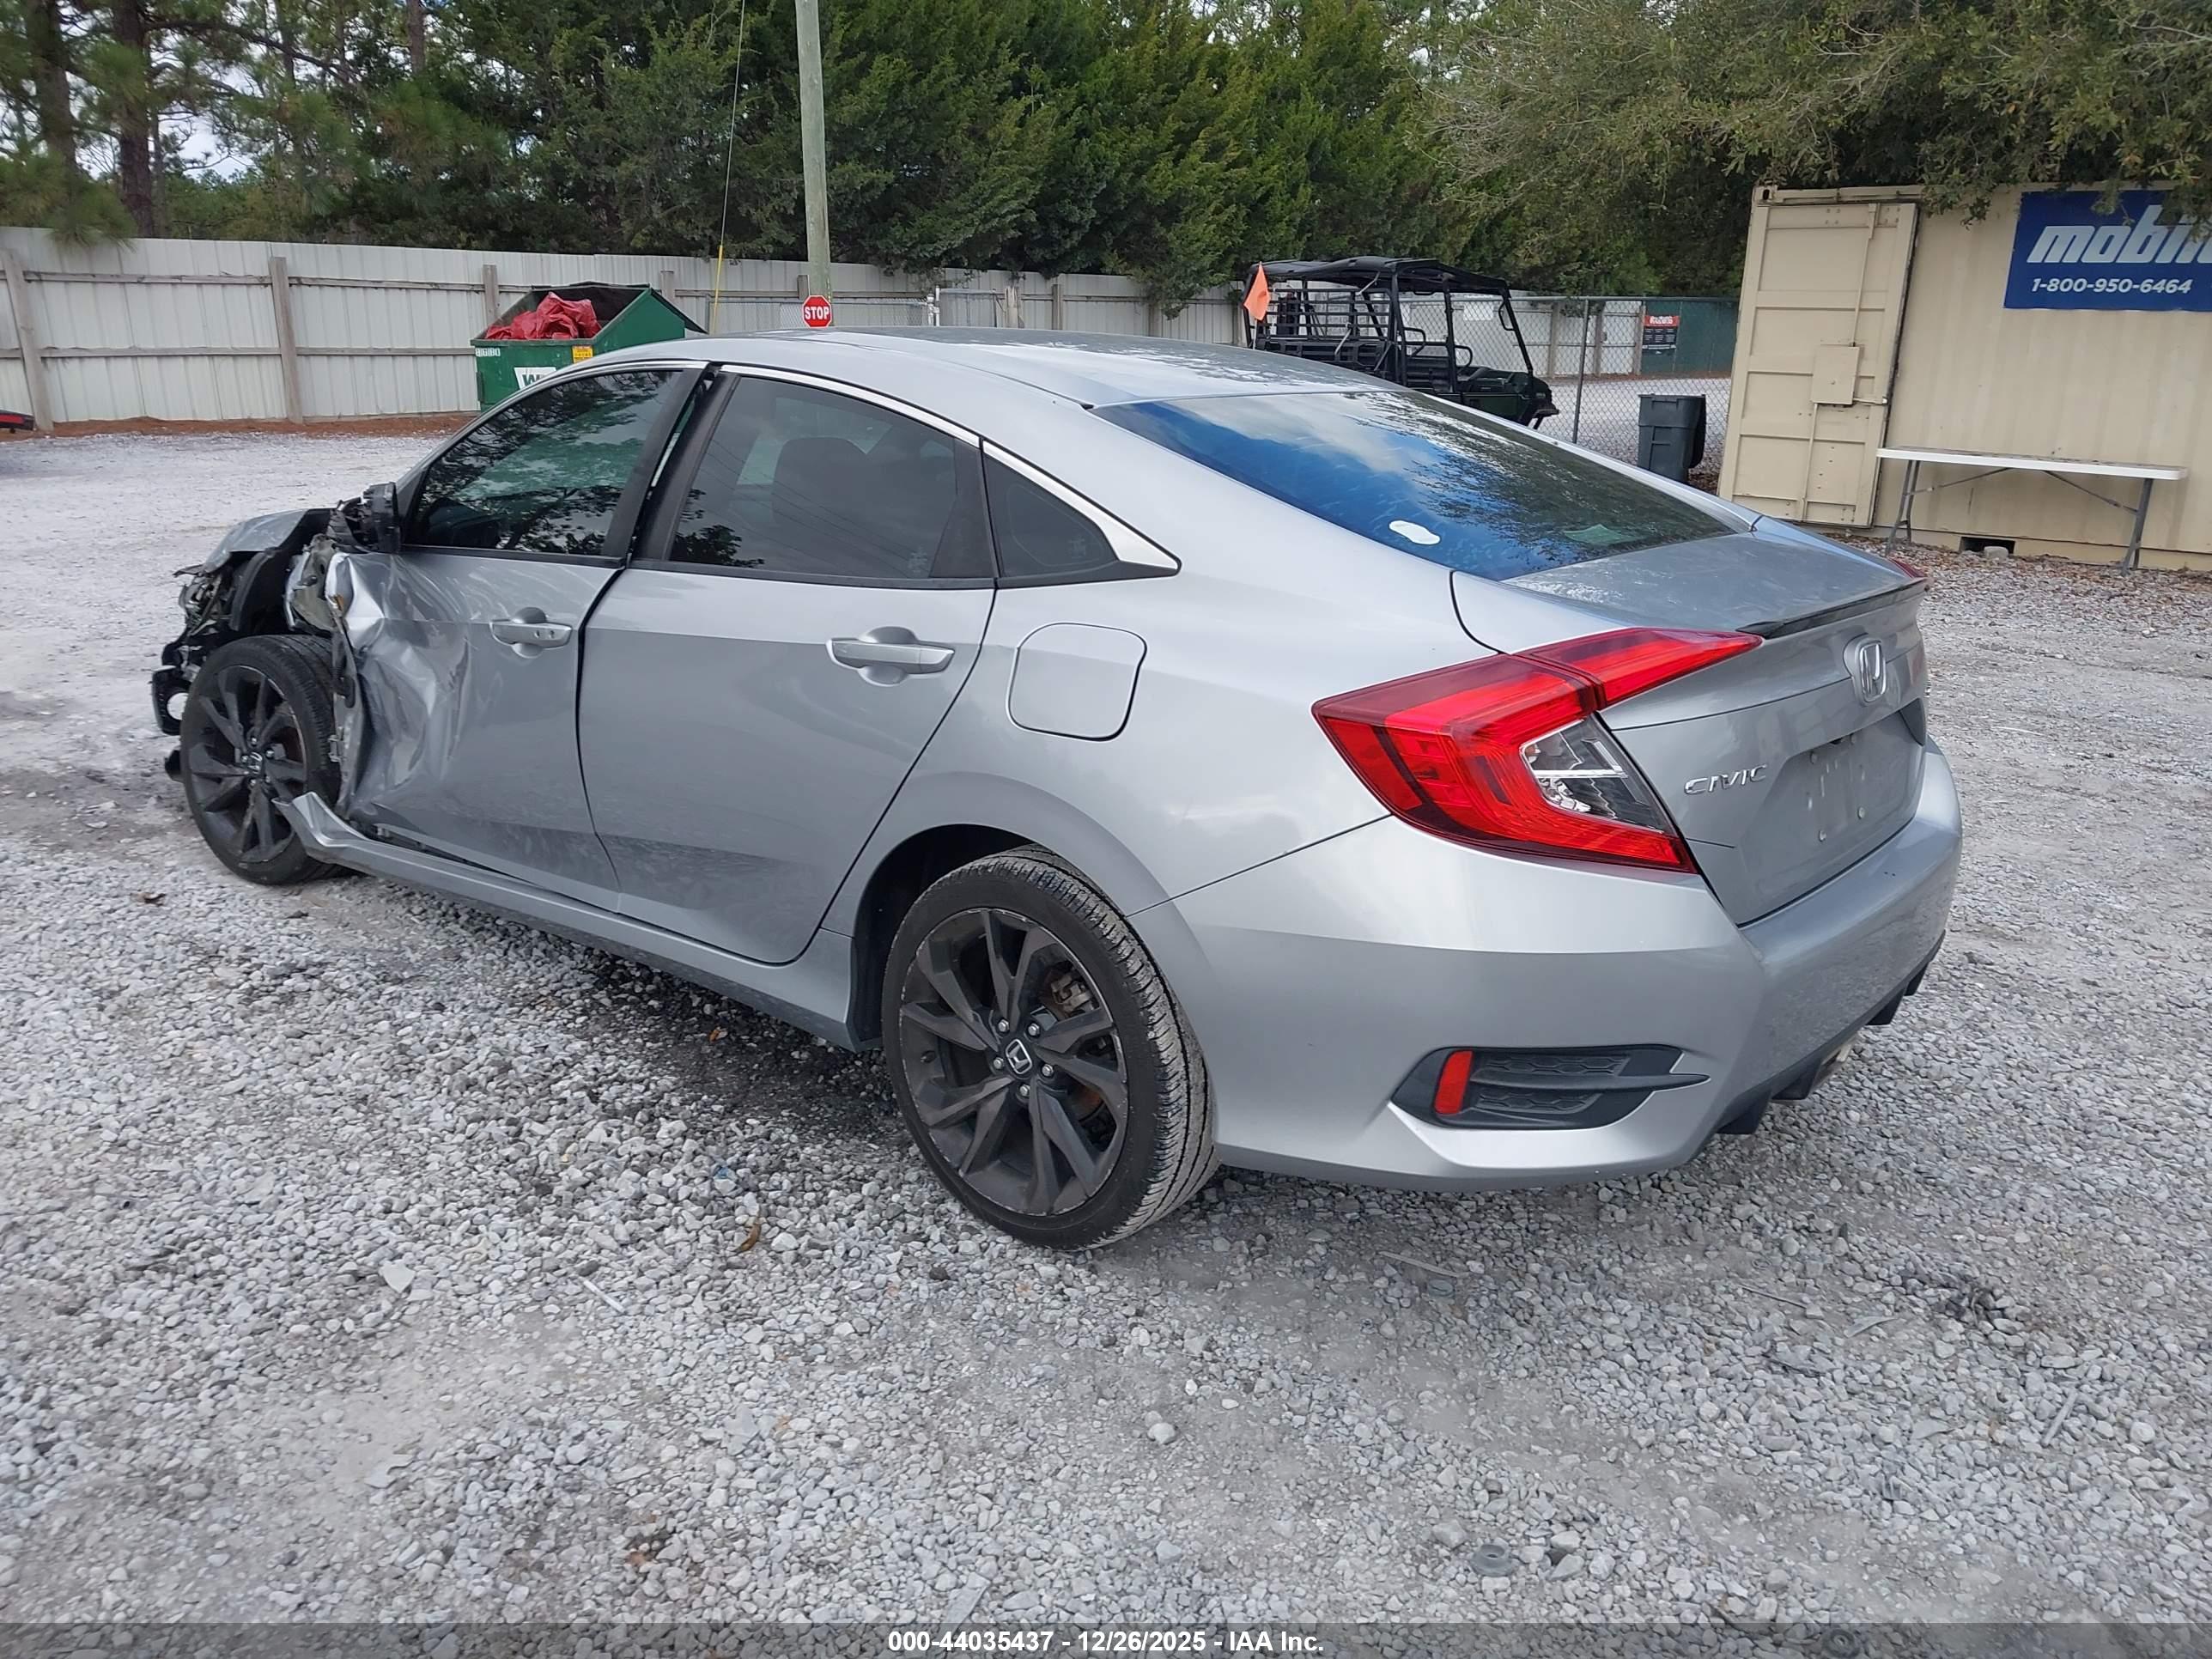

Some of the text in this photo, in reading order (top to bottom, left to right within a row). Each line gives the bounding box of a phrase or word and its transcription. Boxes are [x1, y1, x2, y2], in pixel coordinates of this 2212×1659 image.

[2031, 277, 2193, 295] 1-800-950-6464
[805, 306, 830, 320] STOP
[1684, 763, 1767, 794] CIVIC
